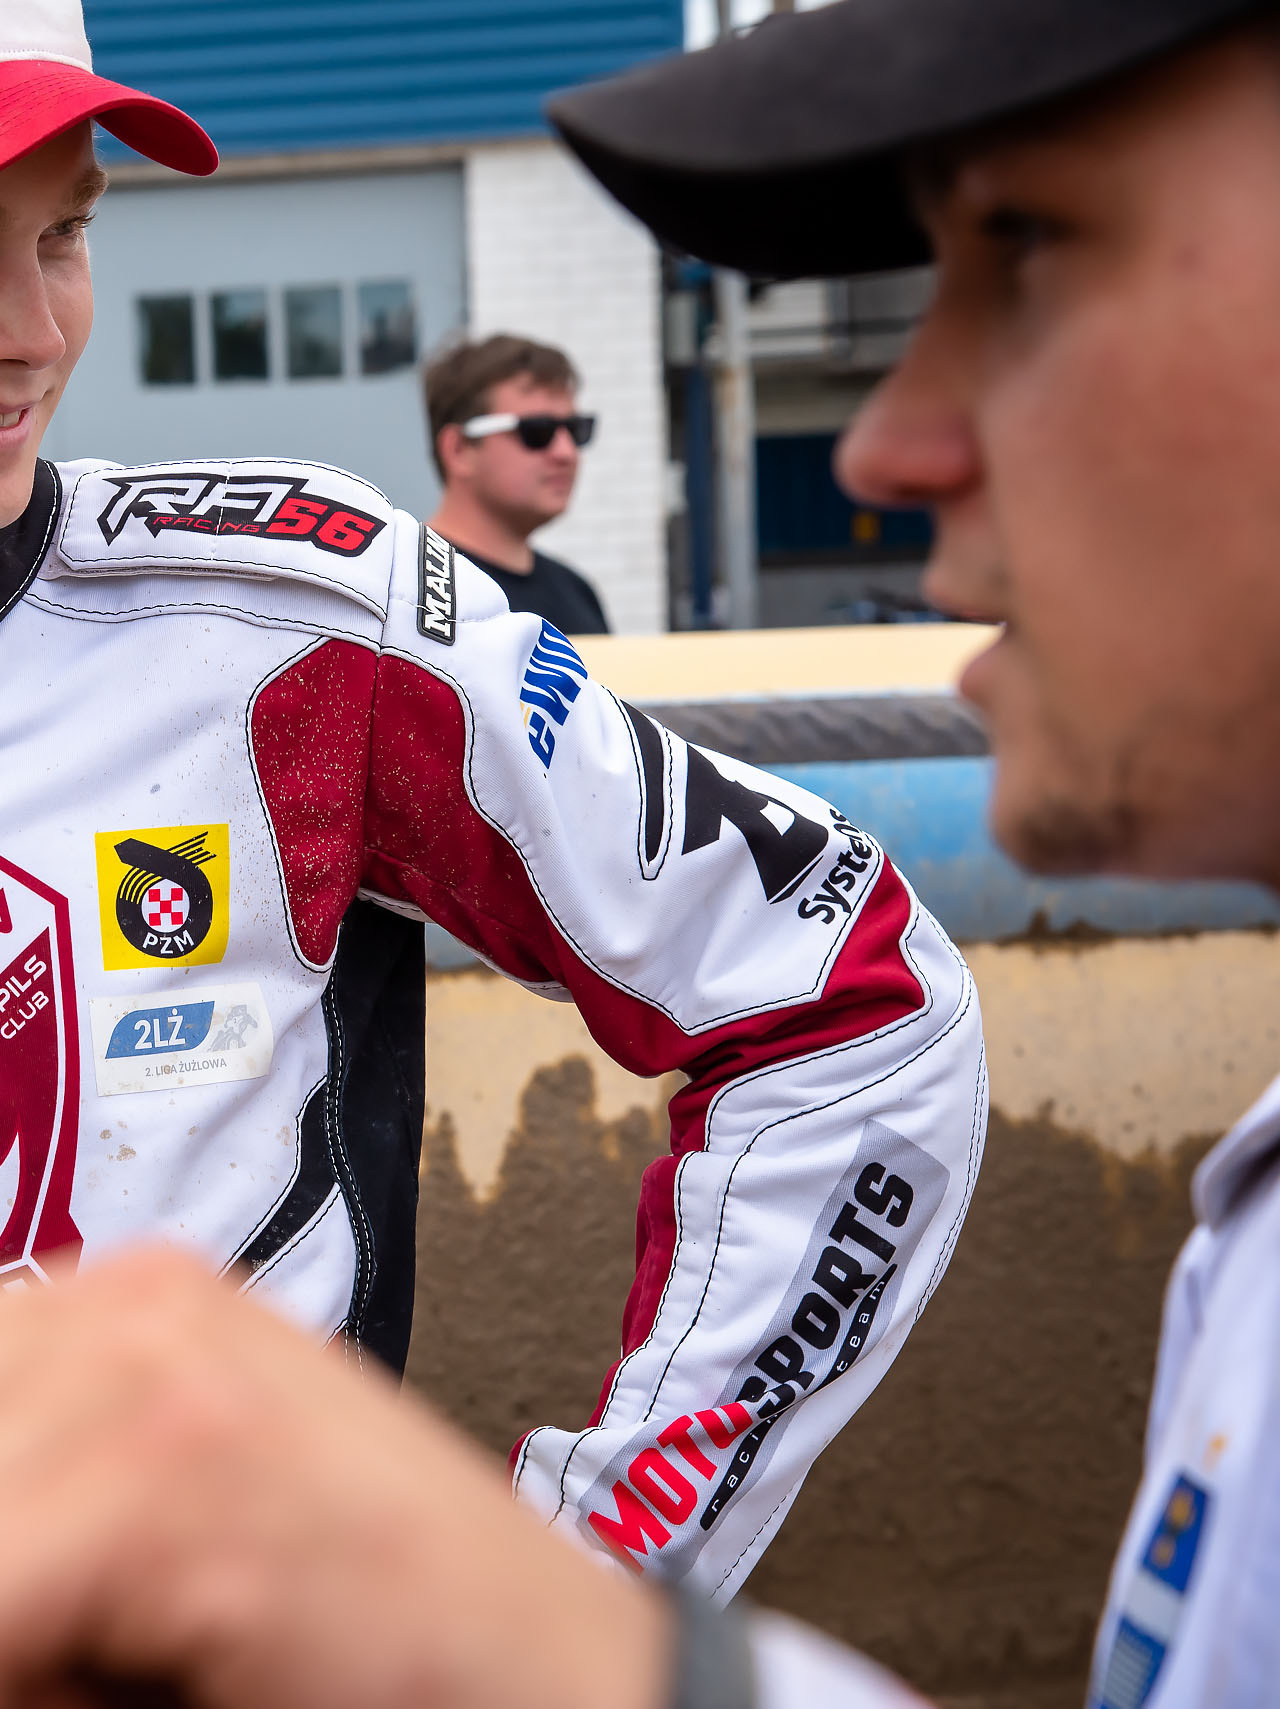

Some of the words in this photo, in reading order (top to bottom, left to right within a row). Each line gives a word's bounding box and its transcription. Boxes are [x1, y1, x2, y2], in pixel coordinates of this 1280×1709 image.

[152, 516, 263, 533] RACING
[142, 929, 195, 954] PZM
[3, 992, 50, 1042] CLUB
[133, 1008, 186, 1051] 2LŻ
[156, 1064, 177, 1076] LIGA
